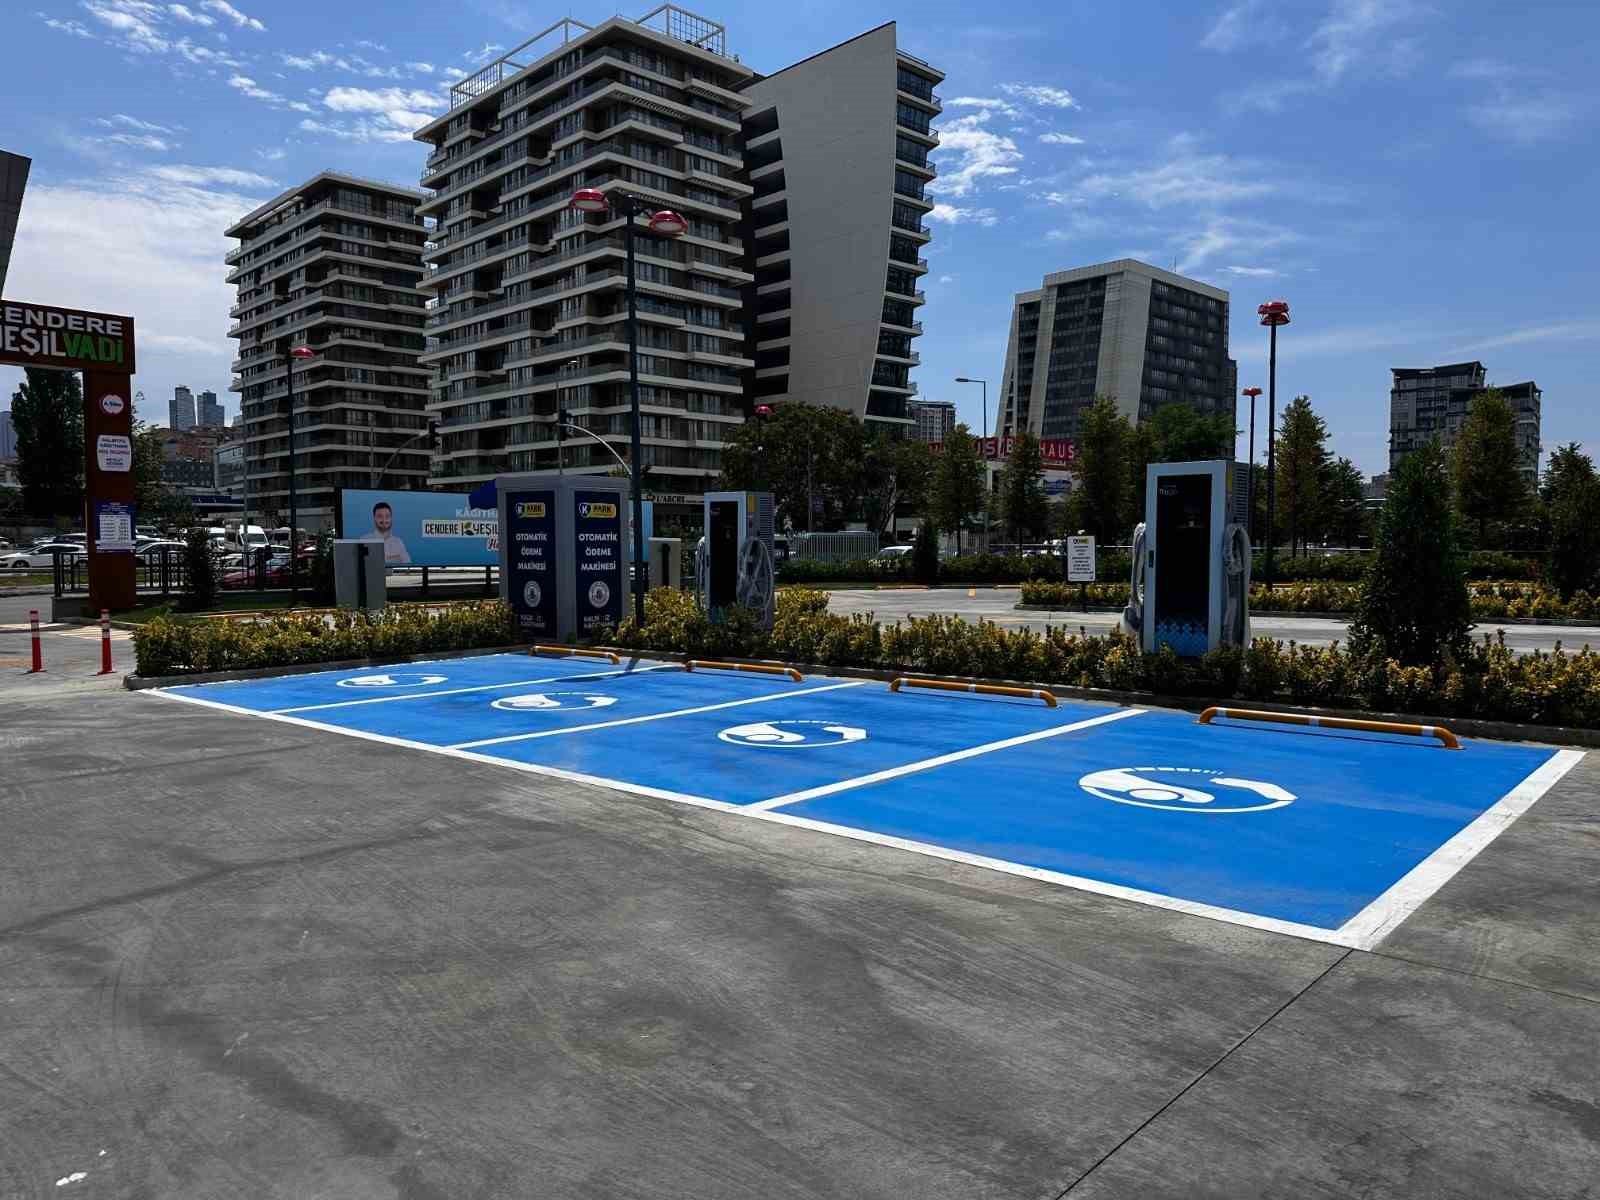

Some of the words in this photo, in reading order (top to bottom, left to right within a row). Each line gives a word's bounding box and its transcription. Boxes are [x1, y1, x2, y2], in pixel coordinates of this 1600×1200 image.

[0, 306, 123, 337] ENDERE
[1006, 438, 1074, 459] BHAUS
[425, 523, 459, 535] CENDERE
[515, 532, 548, 542] OTOMATİK
[578, 531, 618, 542] OTOMATİK
[521, 546, 543, 556] ÖDEME
[585, 546, 612, 556] ÖDEME
[517, 561, 547, 571] MAKİNESİ
[580, 560, 617, 571] MAKİNESİ
